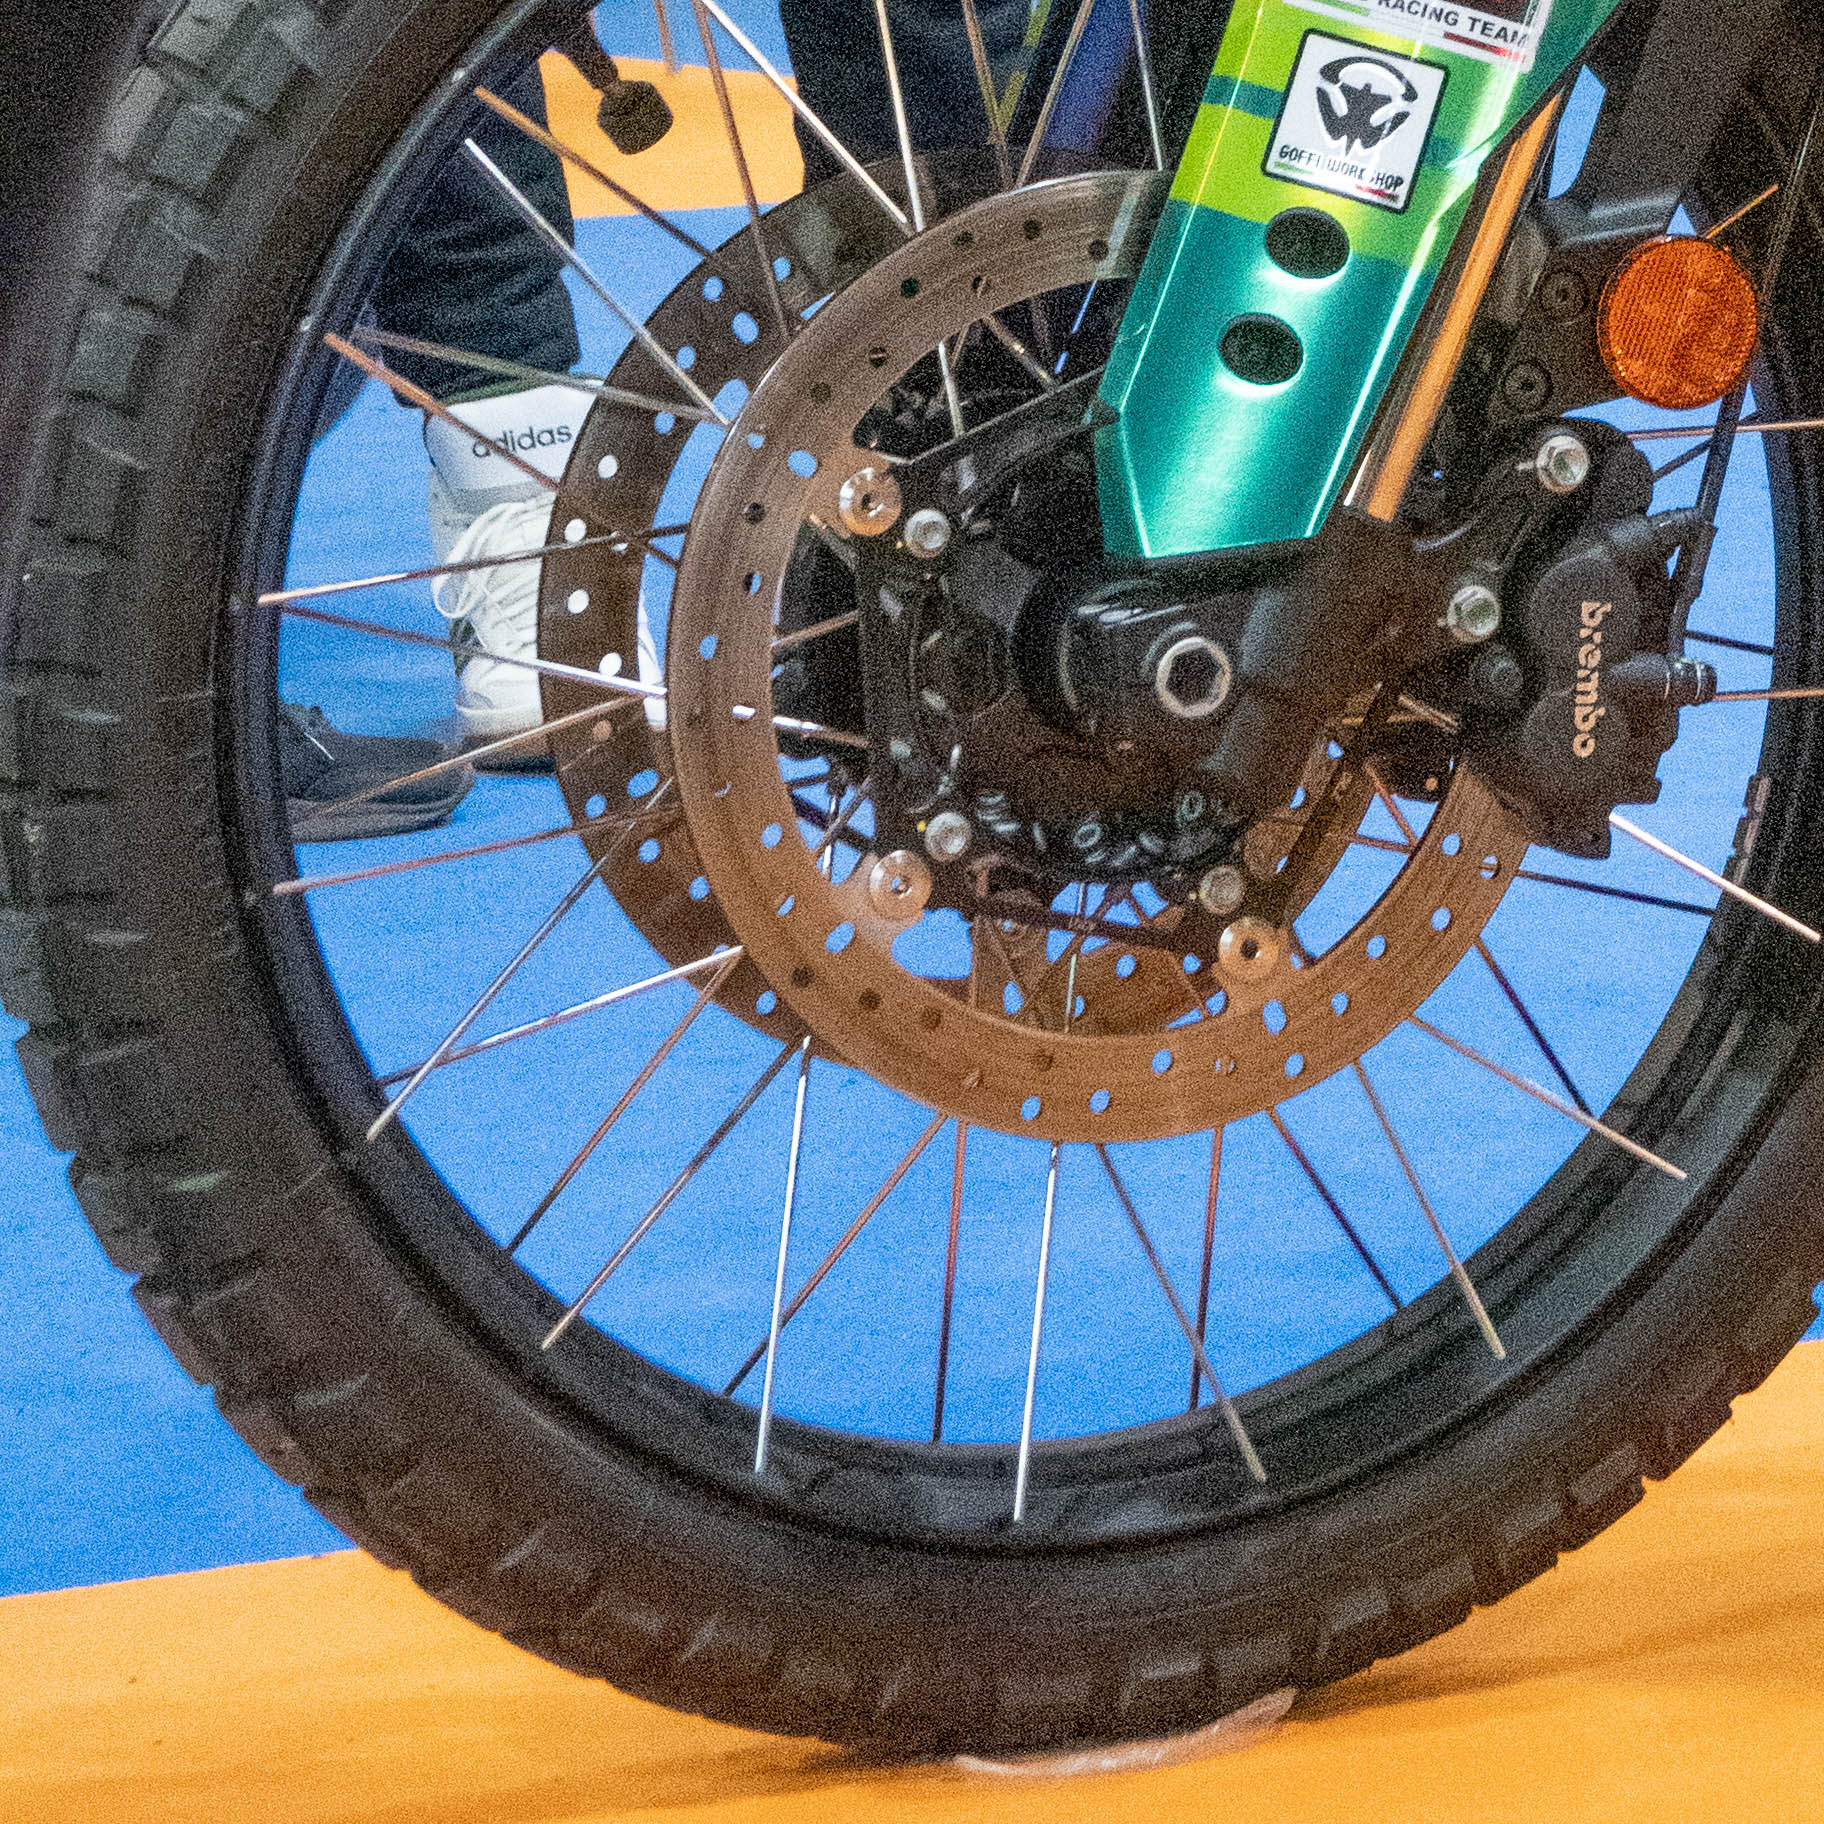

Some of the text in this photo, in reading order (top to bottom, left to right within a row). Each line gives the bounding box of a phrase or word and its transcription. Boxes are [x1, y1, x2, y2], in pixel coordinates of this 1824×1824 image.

[1467, 15, 1530, 48] TEAM
[471, 425, 573, 459] adidas
[1572, 601, 1613, 759] brembo
